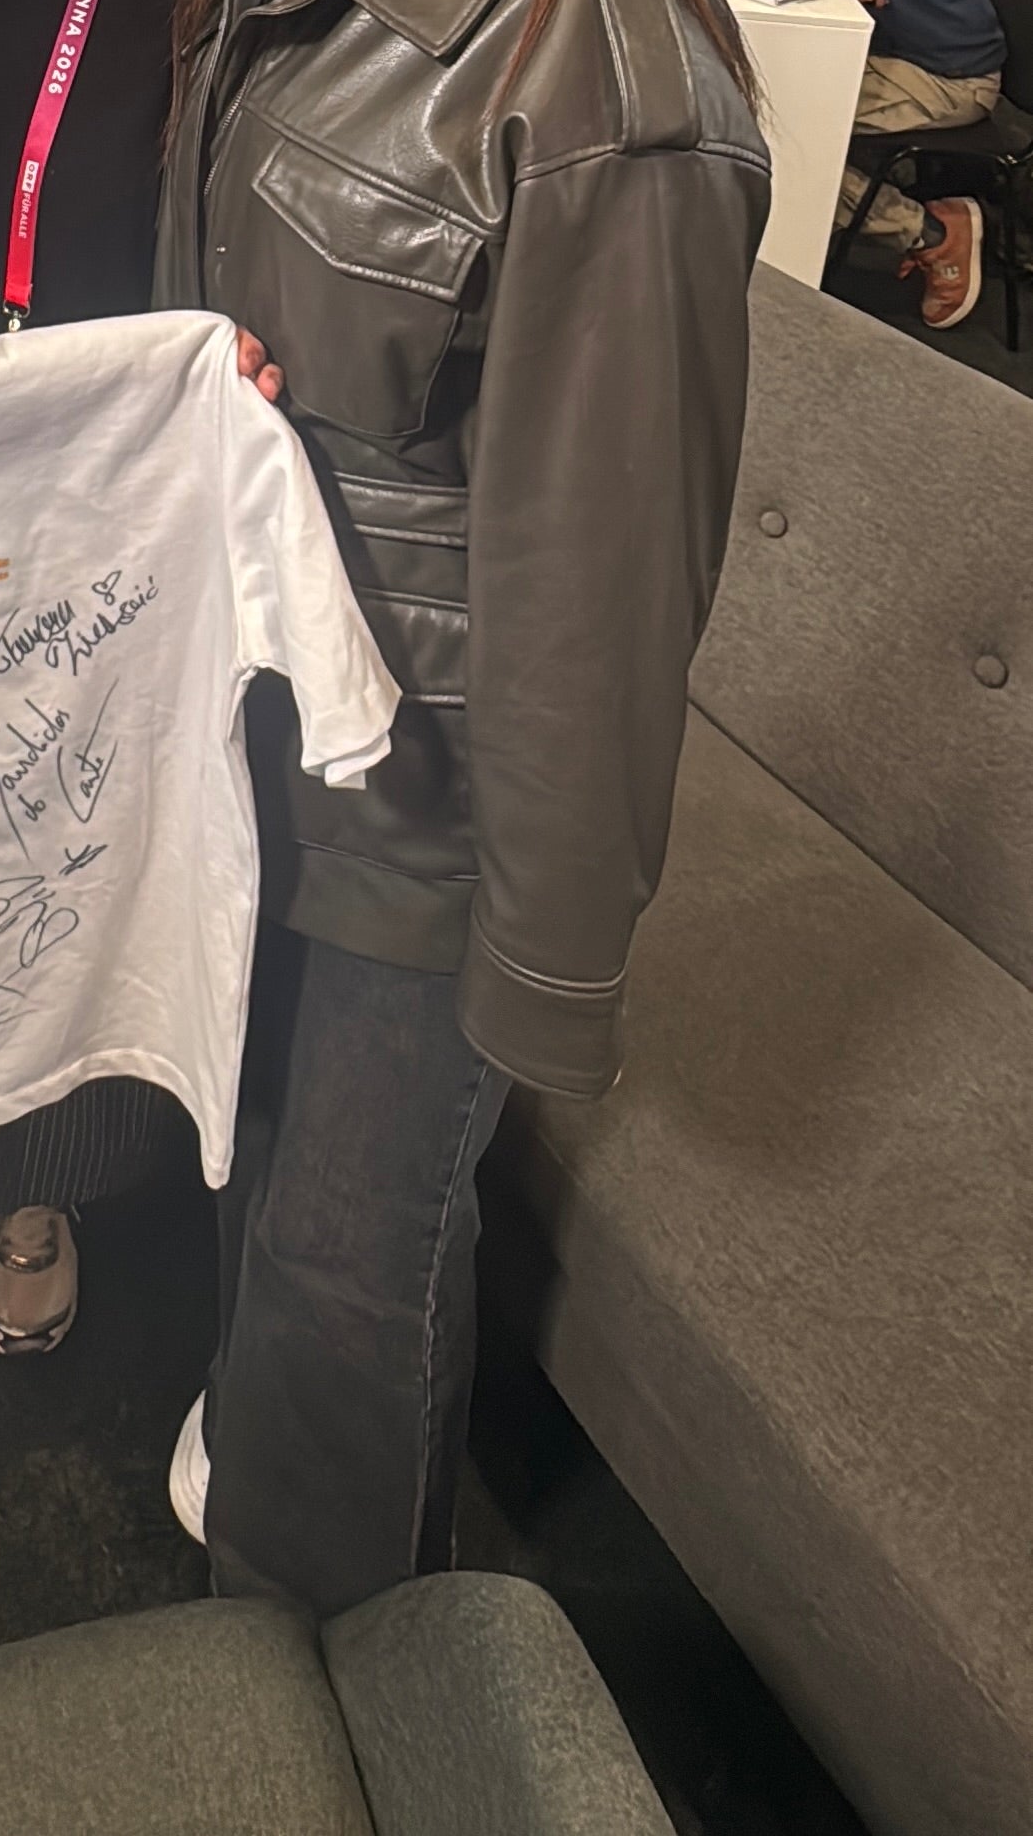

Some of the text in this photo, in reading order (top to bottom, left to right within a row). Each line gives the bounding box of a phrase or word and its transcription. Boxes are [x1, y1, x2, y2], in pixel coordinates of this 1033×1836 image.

[47, 42, 76, 95] 2026
[18, 162, 37, 240] ORF FÜR ALLE
